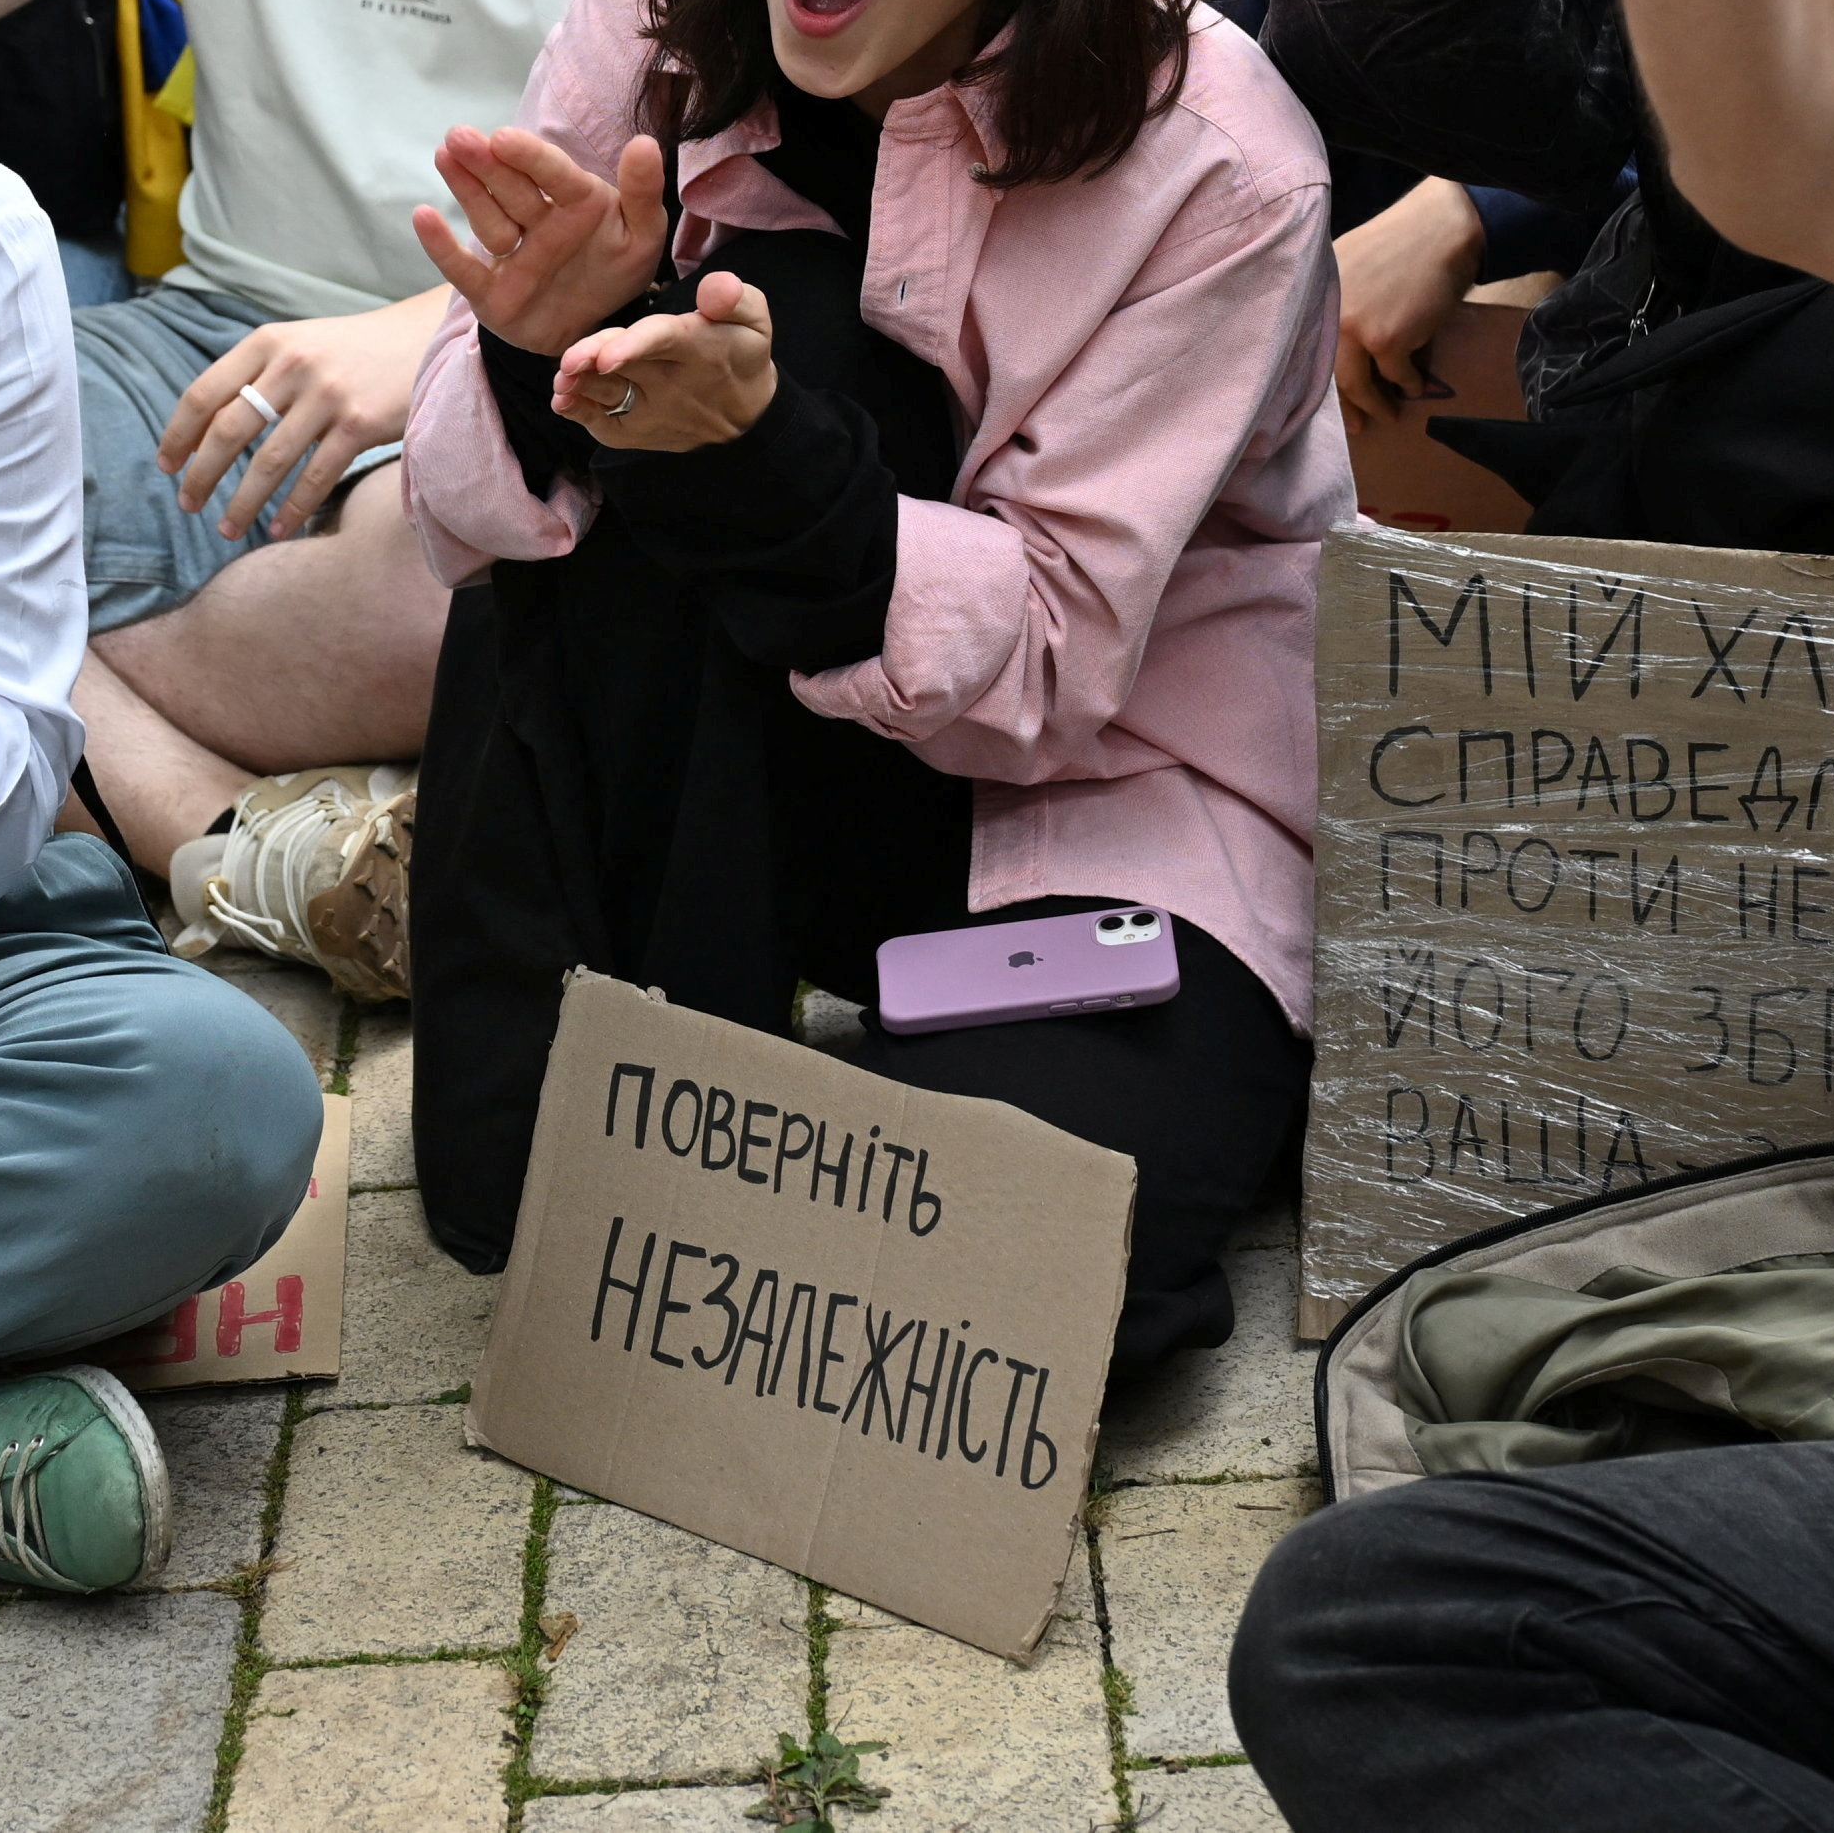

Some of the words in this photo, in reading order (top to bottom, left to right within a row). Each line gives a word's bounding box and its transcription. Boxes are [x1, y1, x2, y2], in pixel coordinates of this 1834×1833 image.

[1388, 570, 1645, 700] МІЙ
[1380, 831, 1679, 937] ПРОТИ
[1382, 946, 1630, 1061] ЙОГО
[604, 1062, 943, 1238] ПОВЕРНІТЬ
[1383, 1087, 1656, 1194] ВАША
[589, 1214, 1060, 1491] НЕЗАЛЕЖНІСТЬ
